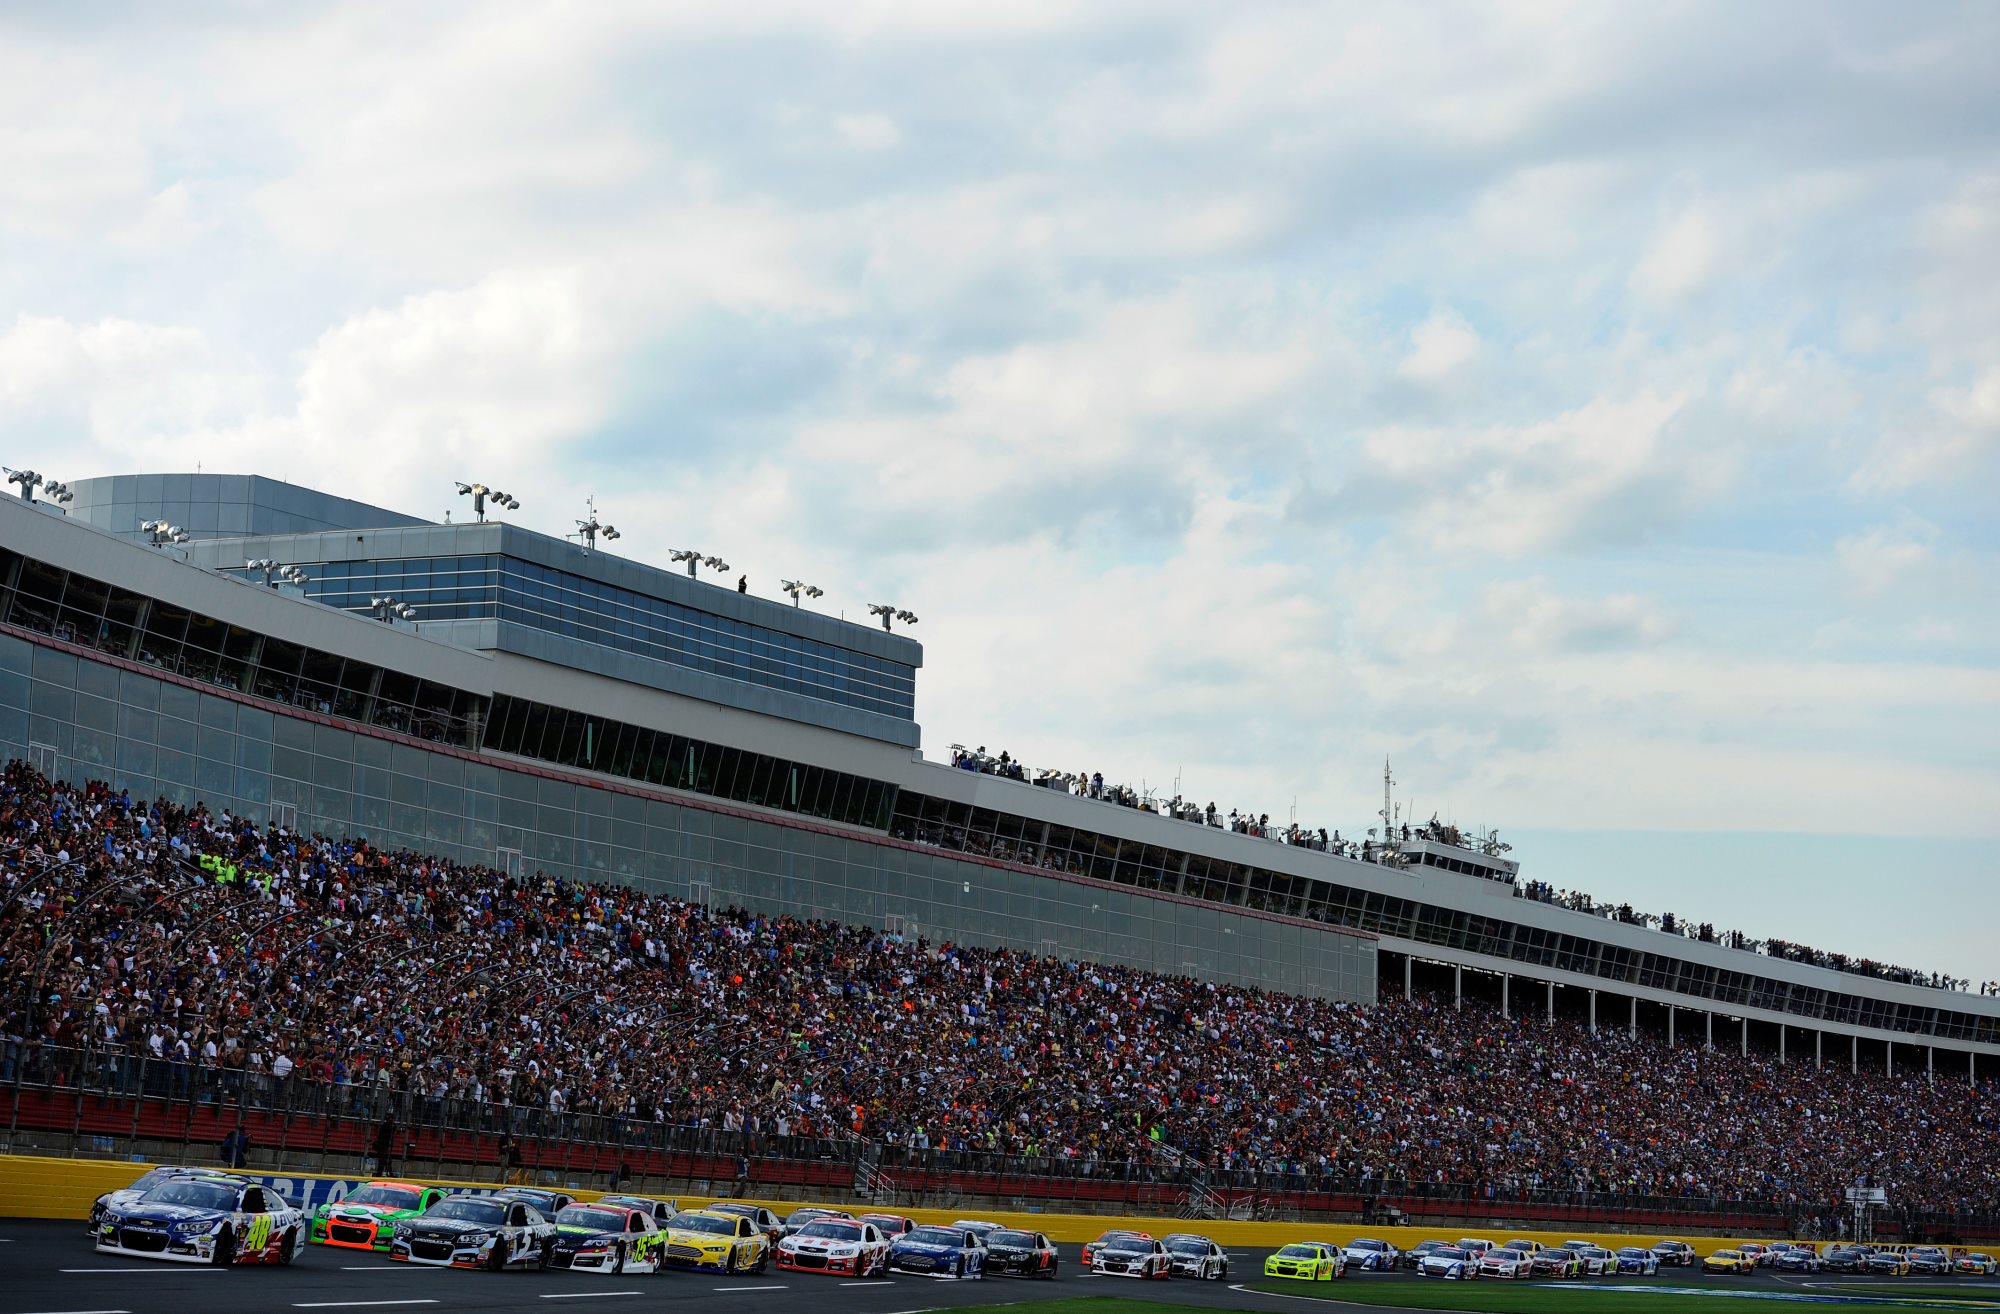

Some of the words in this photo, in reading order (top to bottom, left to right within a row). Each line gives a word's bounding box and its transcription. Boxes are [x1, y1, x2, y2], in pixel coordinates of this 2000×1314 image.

[248, 1215, 271, 1251] 48
[517, 1228, 532, 1258] 5
[634, 1236, 648, 1263] 15
